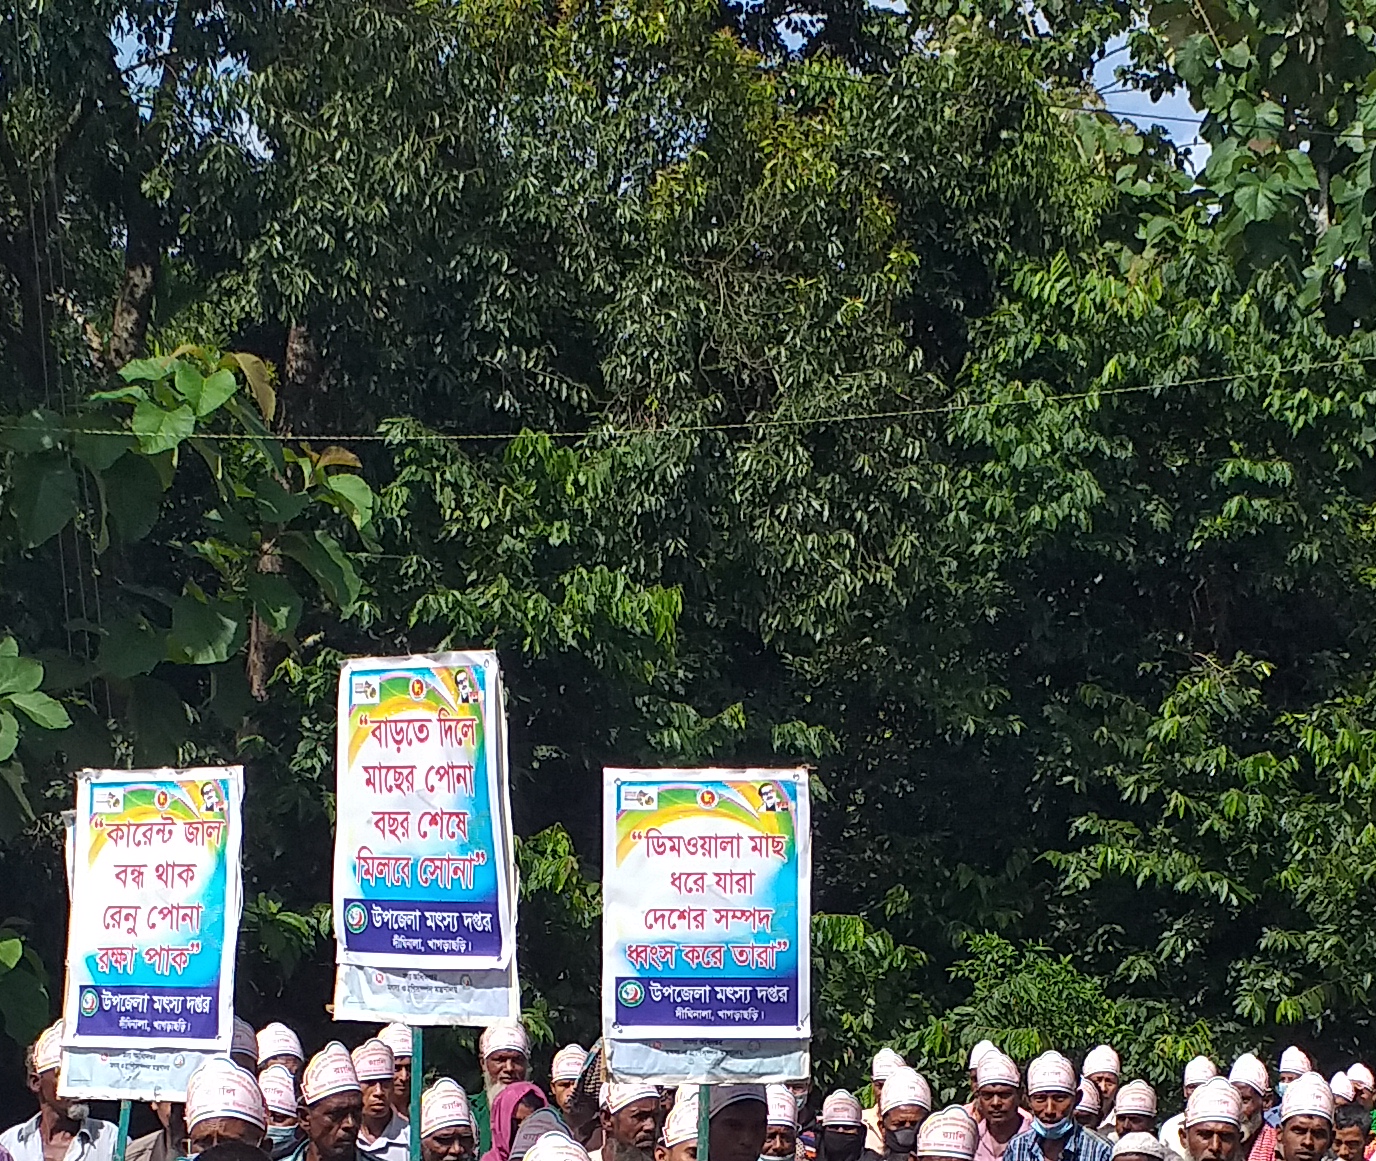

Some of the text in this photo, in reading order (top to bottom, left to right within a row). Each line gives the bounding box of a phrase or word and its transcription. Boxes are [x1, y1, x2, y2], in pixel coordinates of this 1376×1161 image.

[437, 708, 478, 749] দিলে
[363, 762, 474, 795] মাছের পোনা
[184, 817, 225, 846] জাল
[371, 808, 469, 843] বছর শেষে
[749, 834, 788, 861] মাছ
[114, 862, 197, 890] বন্ধ থাক
[355, 847, 412, 887] মিলবে
[671, 869, 756, 895] ধরে যারা
[103, 903, 203, 936] রেনু পোনা
[371, 904, 492, 932] উপজেলা মৎস্য দপ্তর
[645, 908, 774, 933] দেশের সম্পদ
[96, 944, 136, 974] রক্ষা
[626, 944, 676, 970] ধ্বংস
[682, 945, 727, 969] করে
[101, 989, 212, 1014] উপজেলা মৎস্য দপ্তর
[649, 980, 789, 1003] উপজেলা মৎস্য দপ্তর
